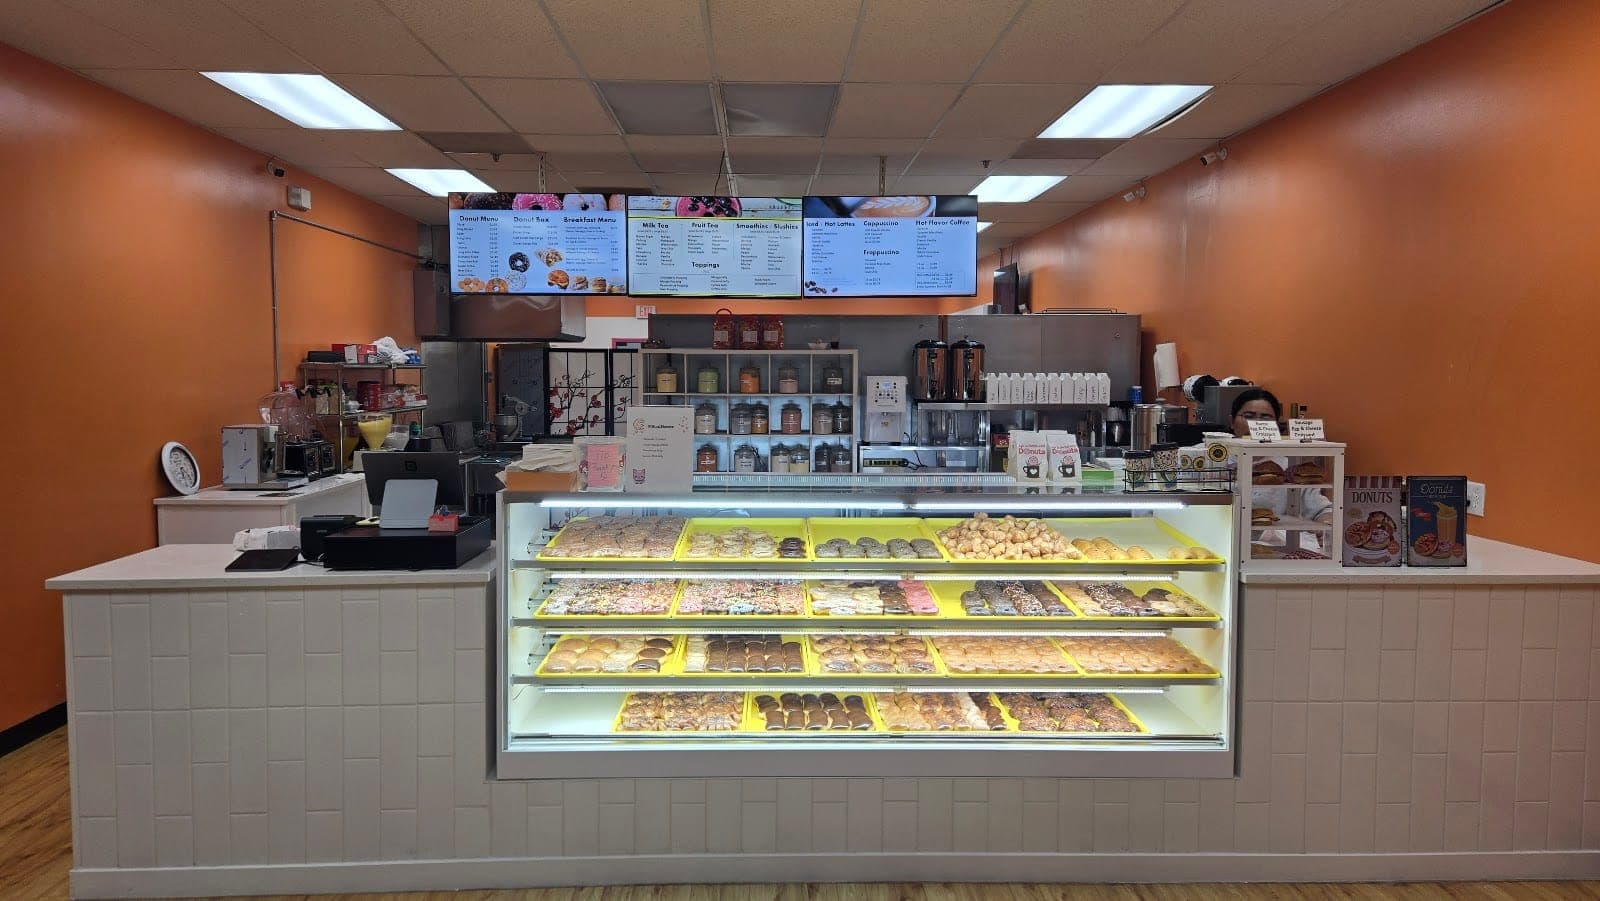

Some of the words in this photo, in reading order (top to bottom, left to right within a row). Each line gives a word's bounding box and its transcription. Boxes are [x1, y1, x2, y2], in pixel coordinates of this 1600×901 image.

[863, 220, 899, 228] Cappuccino
[692, 261, 720, 269] Toppings
[1352, 491, 1393, 503] DONUTS
